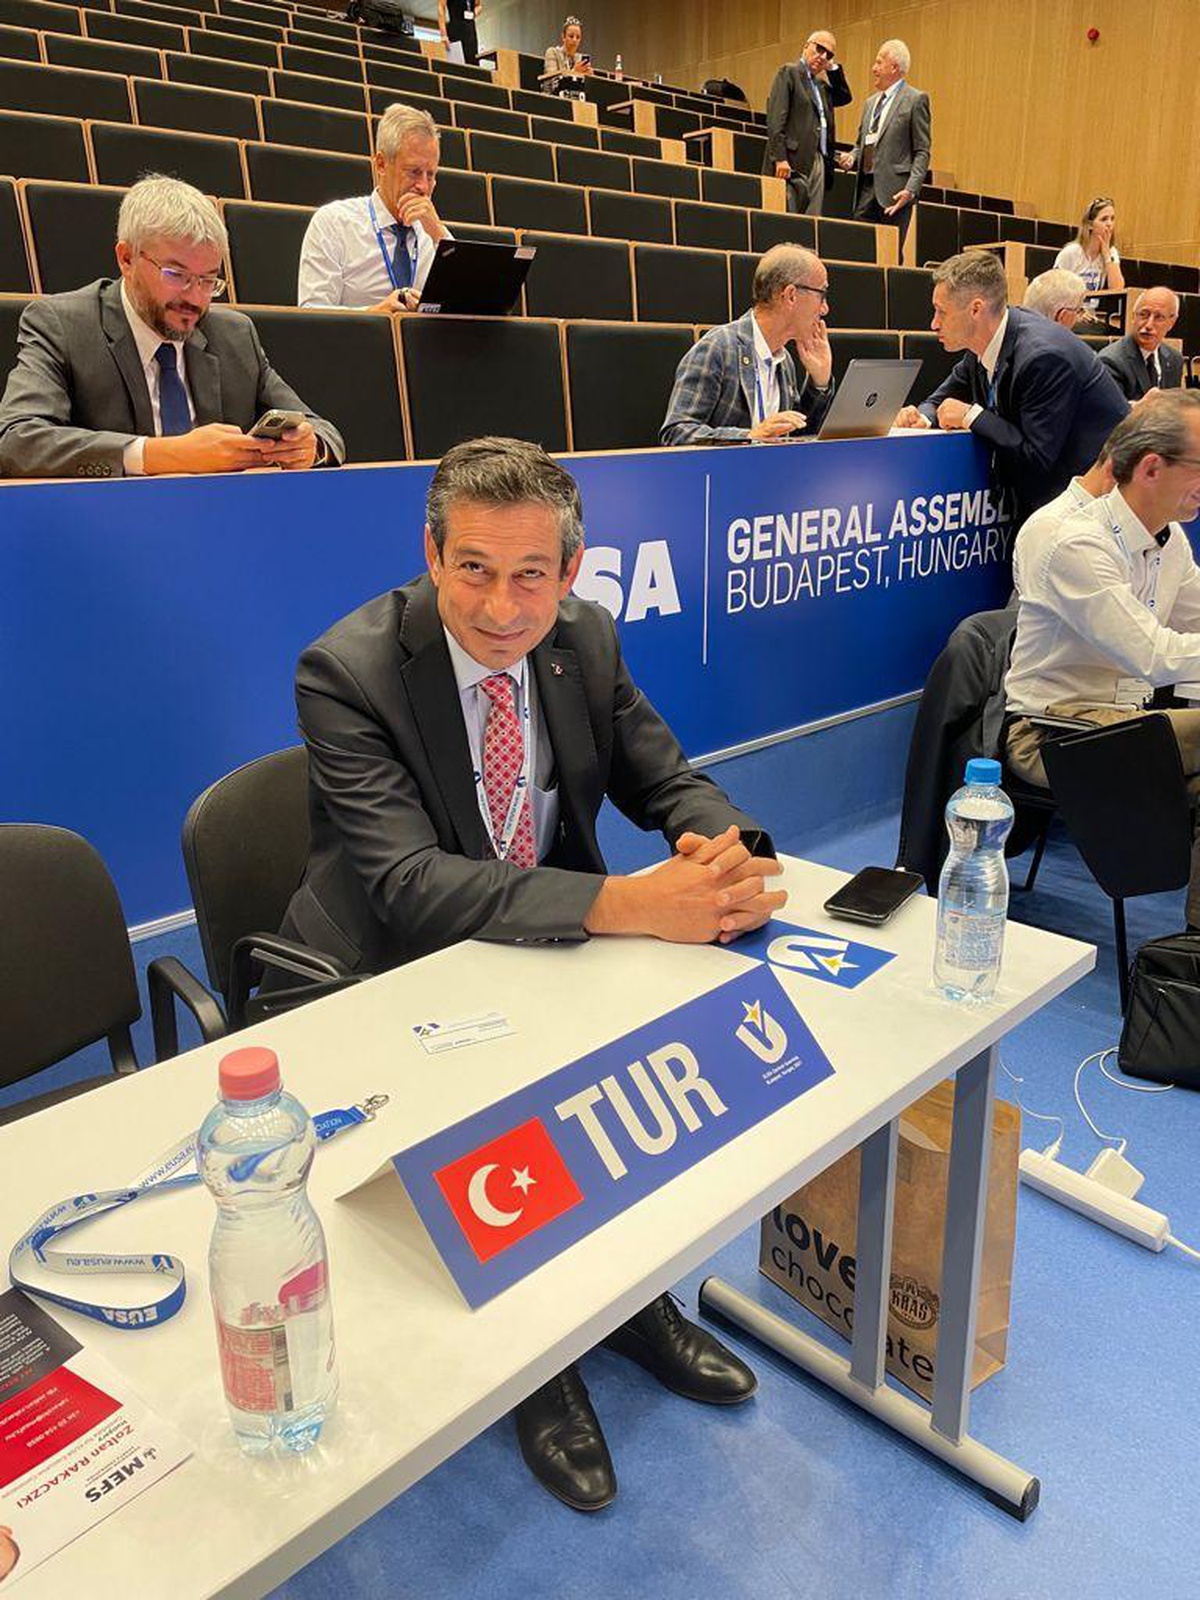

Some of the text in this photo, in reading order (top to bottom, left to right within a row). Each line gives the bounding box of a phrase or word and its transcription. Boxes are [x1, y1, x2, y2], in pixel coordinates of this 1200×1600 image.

[727, 508, 883, 564] GENERAL
[571, 540, 682, 622] SA
[727, 526, 1012, 614] BUDAPEST, HUNGARY
[555, 1042, 729, 1182] TUR
[101, 1305, 158, 1325] EUSA
[91, 1424, 134, 1457] Zoltan
[16, 1457, 91, 1509] RAKACZKI
[85, 1456, 145, 1503] MEFS
